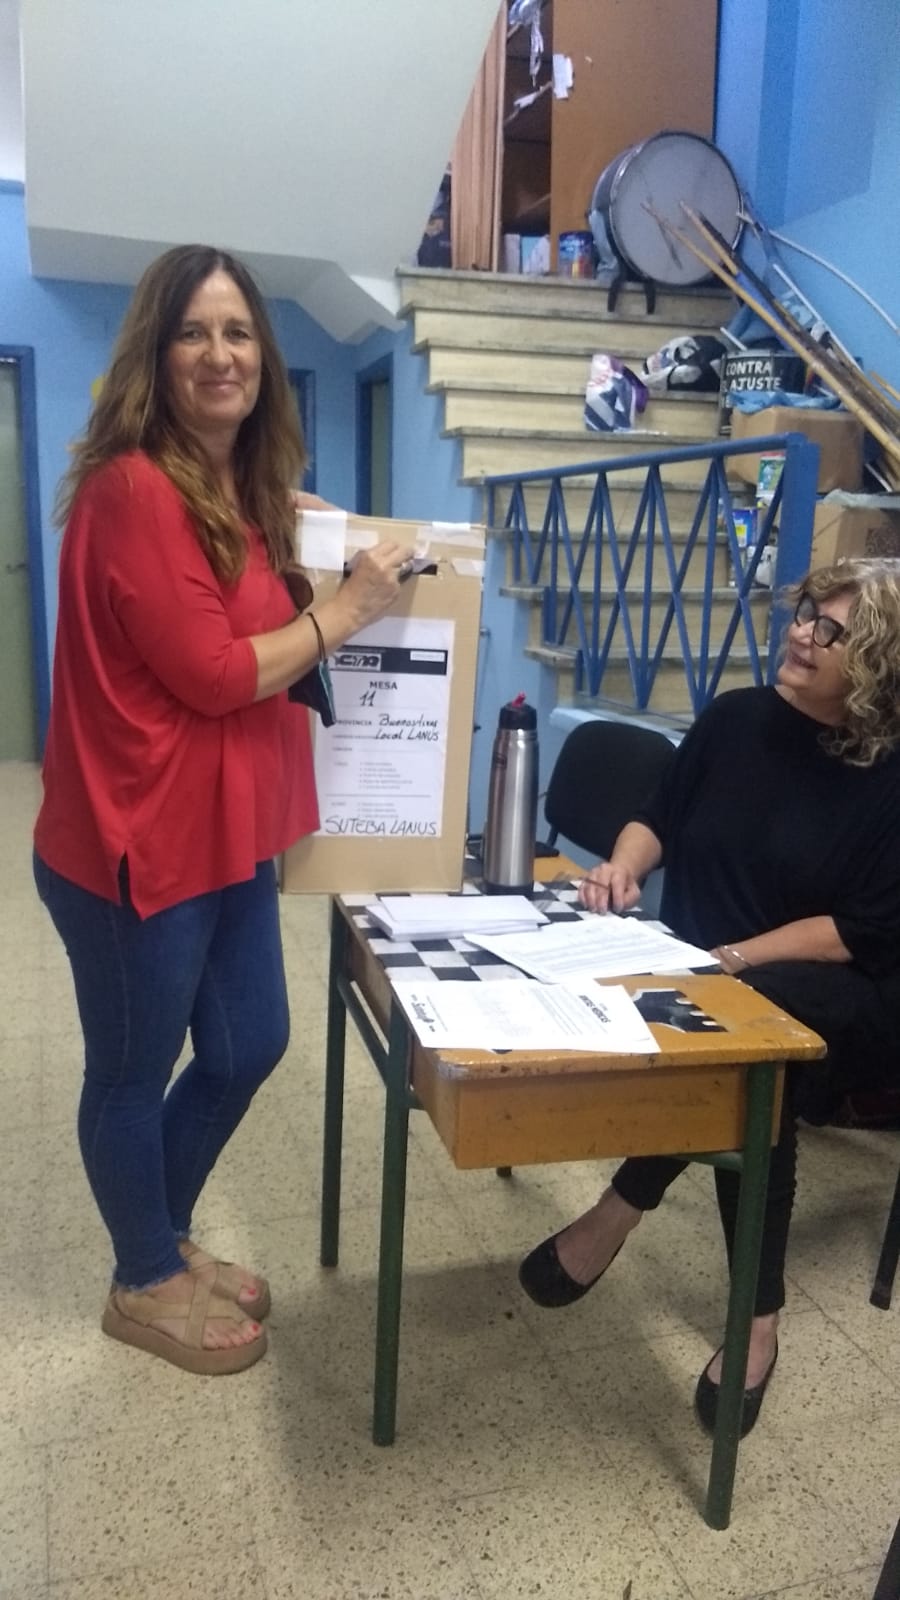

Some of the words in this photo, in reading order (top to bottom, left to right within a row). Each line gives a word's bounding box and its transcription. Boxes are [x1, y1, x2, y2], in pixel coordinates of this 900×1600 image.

[726, 361, 771, 375] CONTRA
[730, 377, 781, 392] AJUSTE
[370, 682, 397, 690] MESA
[360, 690, 376, 707] 11
[375, 728, 403, 740] Local
[325, 815, 385, 837] SUTEBA
[390, 819, 437, 837] LANUS
